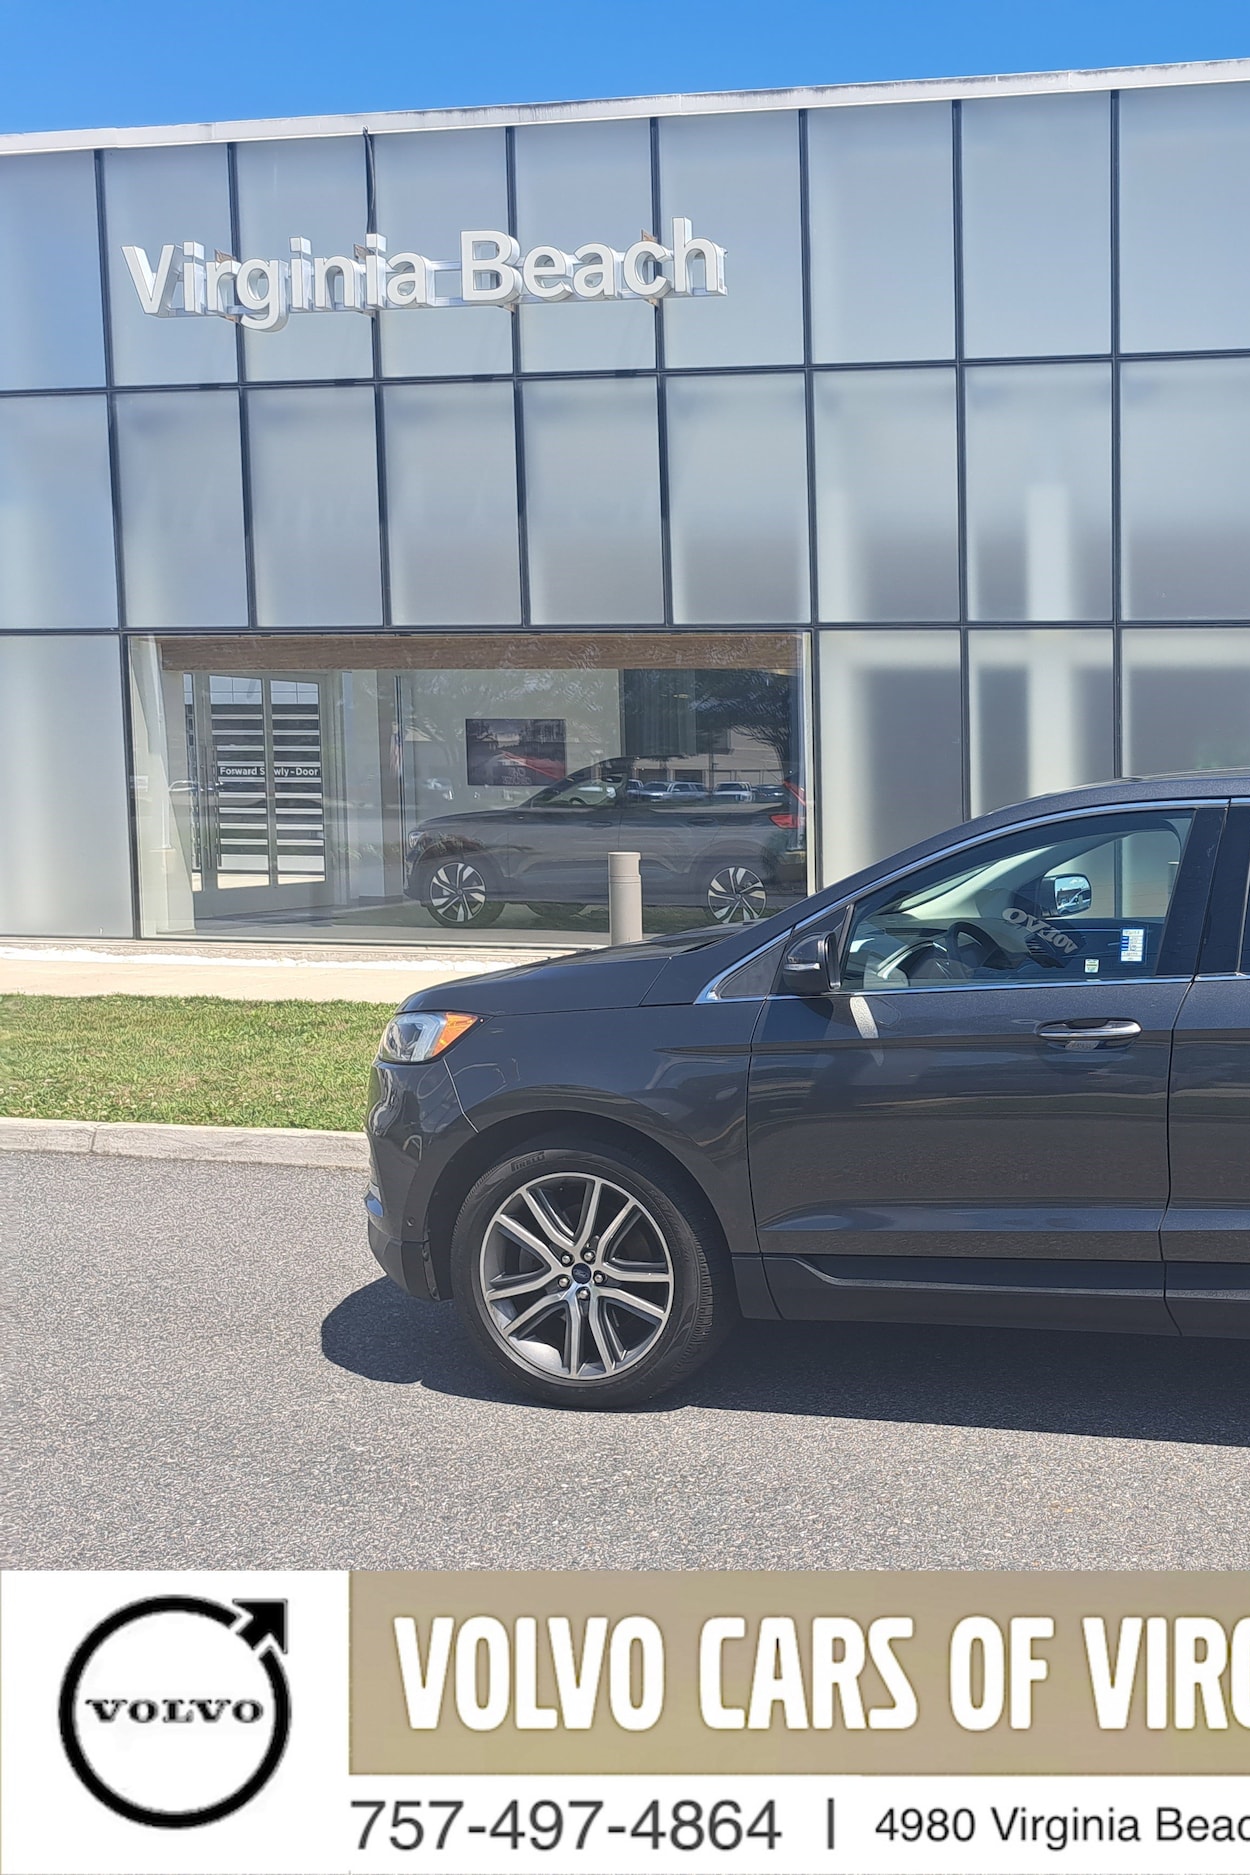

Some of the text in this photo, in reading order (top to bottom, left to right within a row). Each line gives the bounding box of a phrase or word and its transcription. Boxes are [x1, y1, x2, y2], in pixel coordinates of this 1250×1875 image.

[121, 217, 727, 332] Virginia Beach
[220, 766, 257, 776] Forward
[259, 767, 288, 777] Swly
[296, 767, 319, 776] Door
